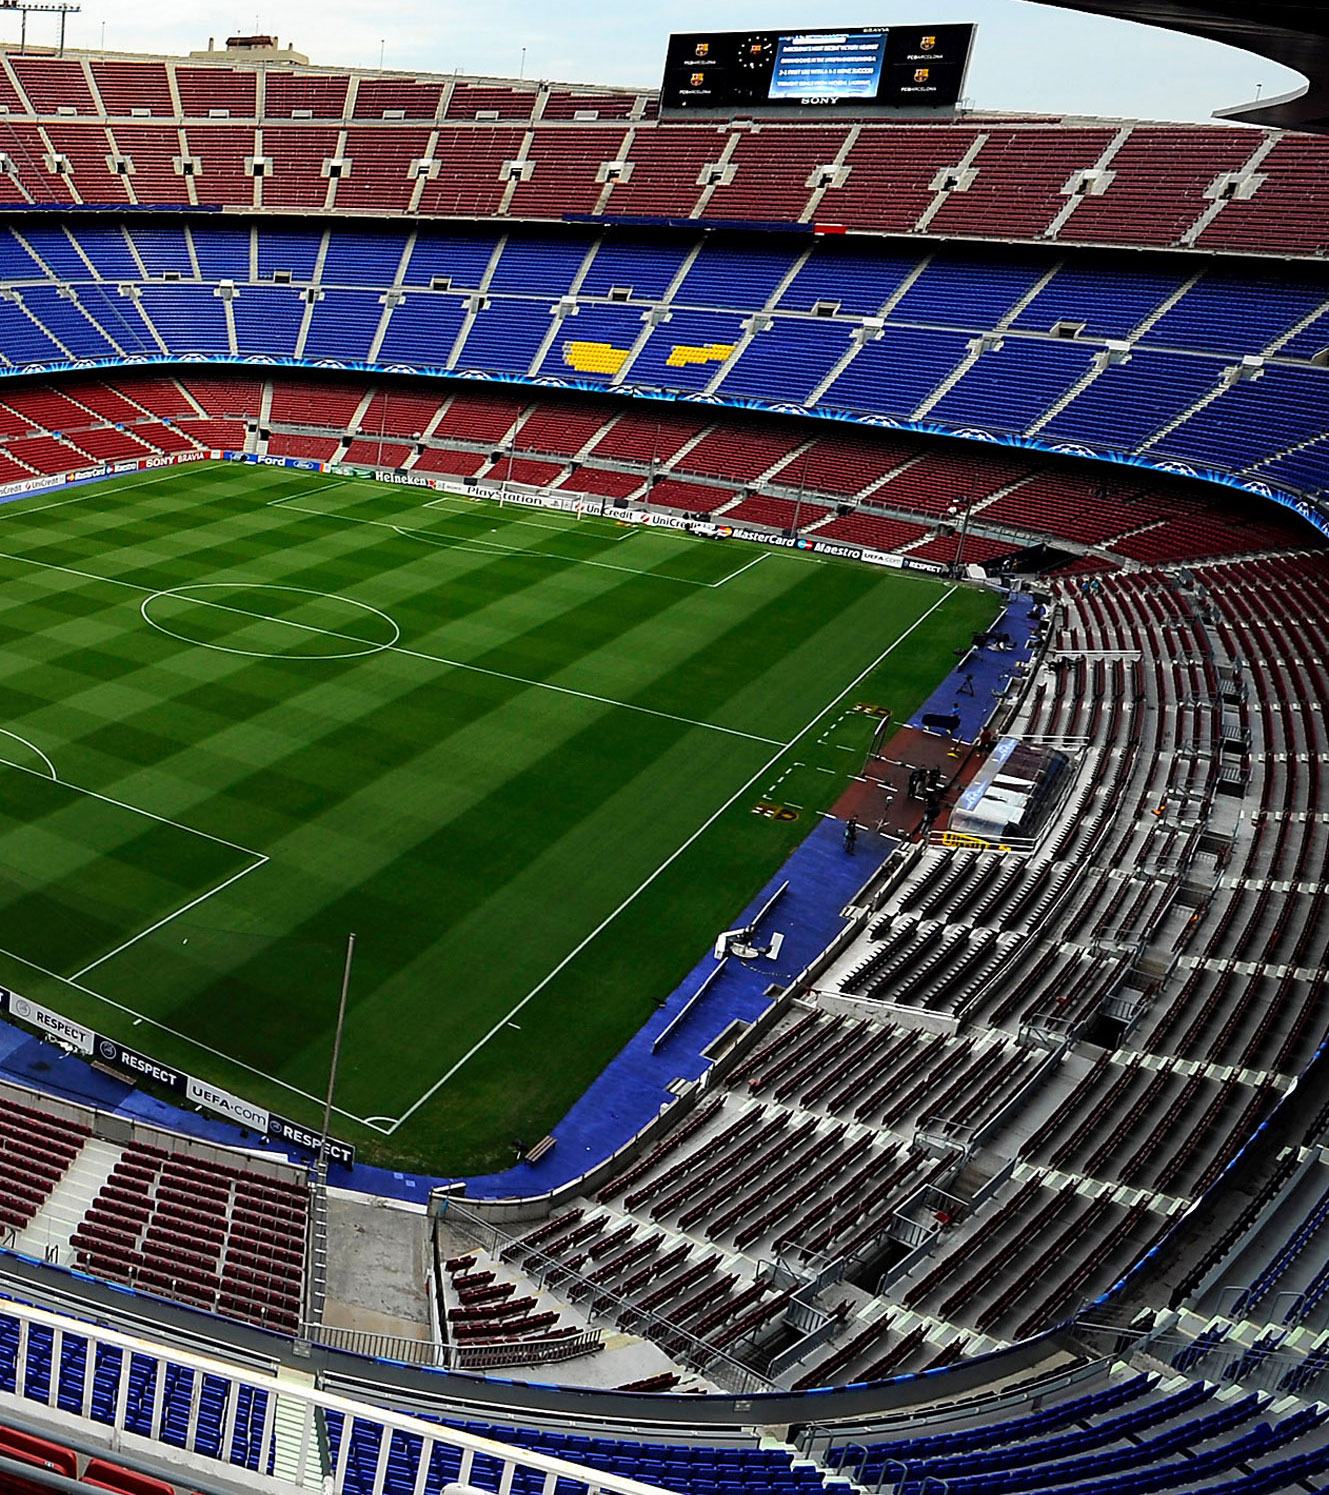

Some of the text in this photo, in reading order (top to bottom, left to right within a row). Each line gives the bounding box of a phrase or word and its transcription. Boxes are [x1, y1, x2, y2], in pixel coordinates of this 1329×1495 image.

[146, 456, 175, 468] SONY
[258, 455, 286, 467] Ford
[375, 471, 426, 486] Heineken
[587, 505, 633, 520] UnCredit
[732, 528, 796, 547] MasterCard
[814, 542, 861, 559] Maestro
[909, 561, 942, 574] RESPECT
[36, 1010, 87, 1043] RESPECT
[122, 1052, 177, 1086] RESPECT
[283, 1125, 352, 1161] RESPECT
